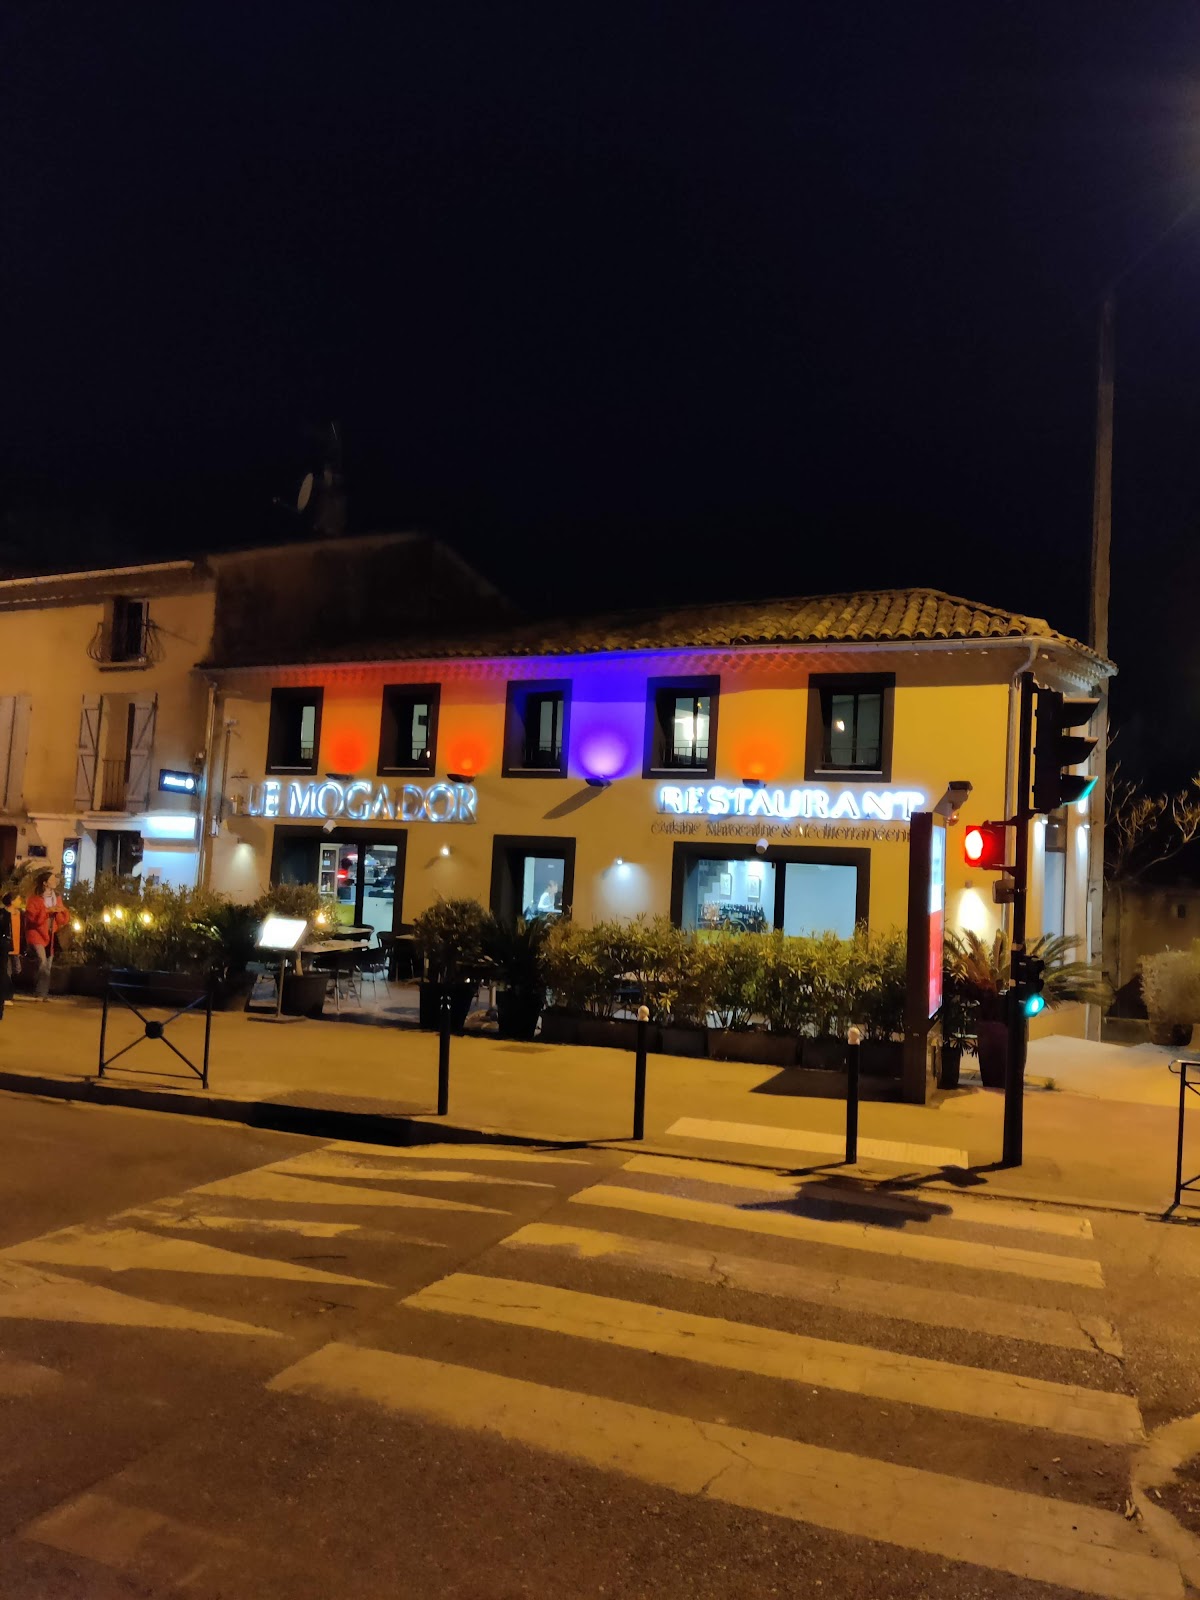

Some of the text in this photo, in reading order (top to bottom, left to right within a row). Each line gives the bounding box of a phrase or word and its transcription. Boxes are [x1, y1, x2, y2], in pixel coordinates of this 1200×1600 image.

[248, 781, 477, 823] LE MOGADOR
[660, 786, 924, 821] RESTAURANT
[650, 819, 701, 836] Cuisine
[705, 821, 780, 838] Marocaine
[781, 823, 793, 838] &
